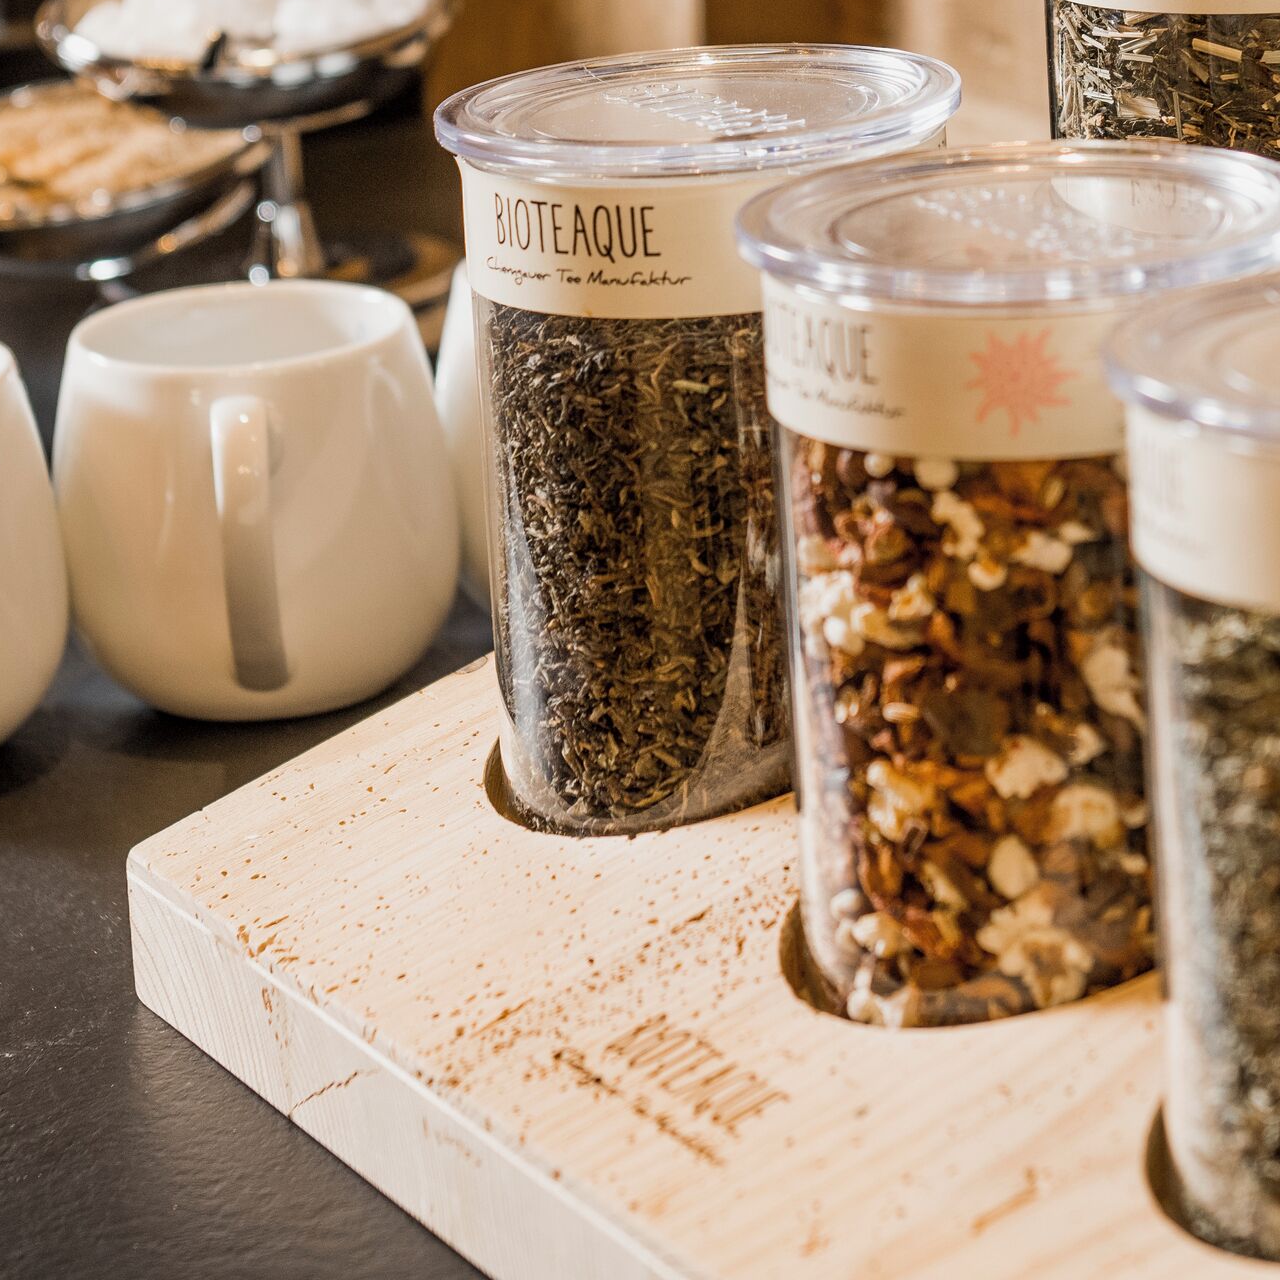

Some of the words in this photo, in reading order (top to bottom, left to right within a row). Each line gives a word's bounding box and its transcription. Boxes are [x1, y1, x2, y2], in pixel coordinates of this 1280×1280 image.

[495, 192, 661, 263] BIOTEAQUE
[556, 269, 581, 285] Tee
[586, 270, 693, 287] Manufaktur
